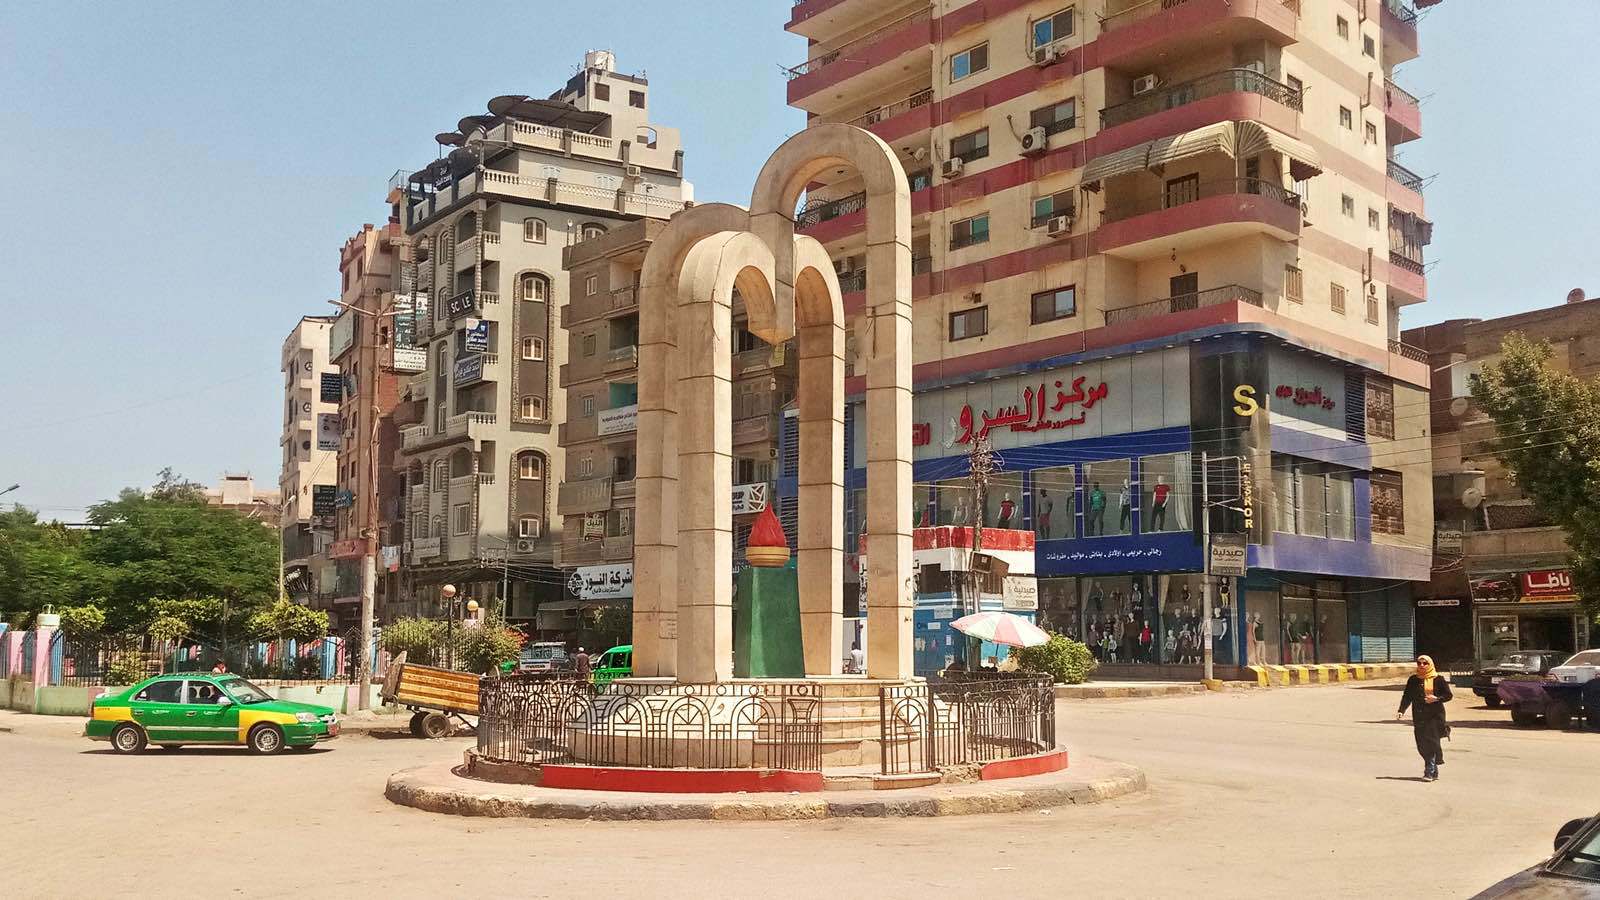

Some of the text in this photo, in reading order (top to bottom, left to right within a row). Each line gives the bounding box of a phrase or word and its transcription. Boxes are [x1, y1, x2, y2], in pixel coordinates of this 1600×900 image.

[1051, 375, 1109, 412] مركز
[1232, 384, 1259, 417] S
[1213, 548, 1244, 558] صيدلية
[610, 568, 633, 588] شركة
[1528, 572, 1571, 592] باظا
